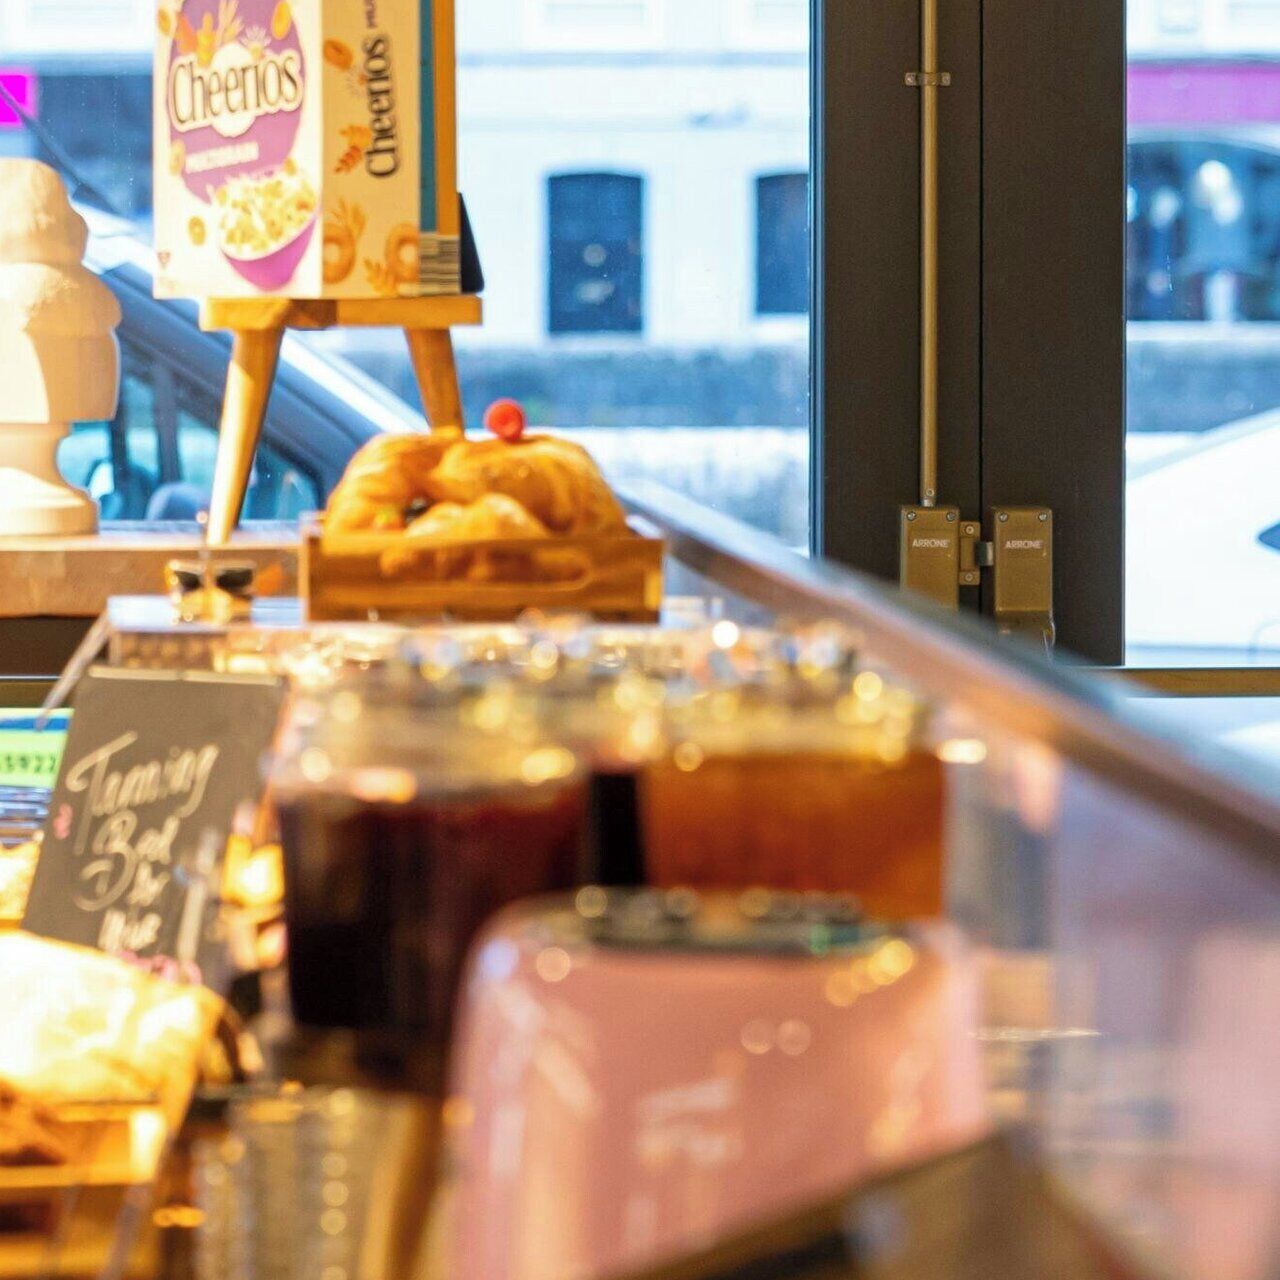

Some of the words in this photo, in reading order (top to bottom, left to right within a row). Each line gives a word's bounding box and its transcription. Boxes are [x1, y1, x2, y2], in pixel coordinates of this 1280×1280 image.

[173, 55, 298, 125] Cheerios
[363, 35, 399, 179] Cheerios
[912, 538, 949, 549] ARRONE
[1005, 539, 1042, 550] ARRONE
